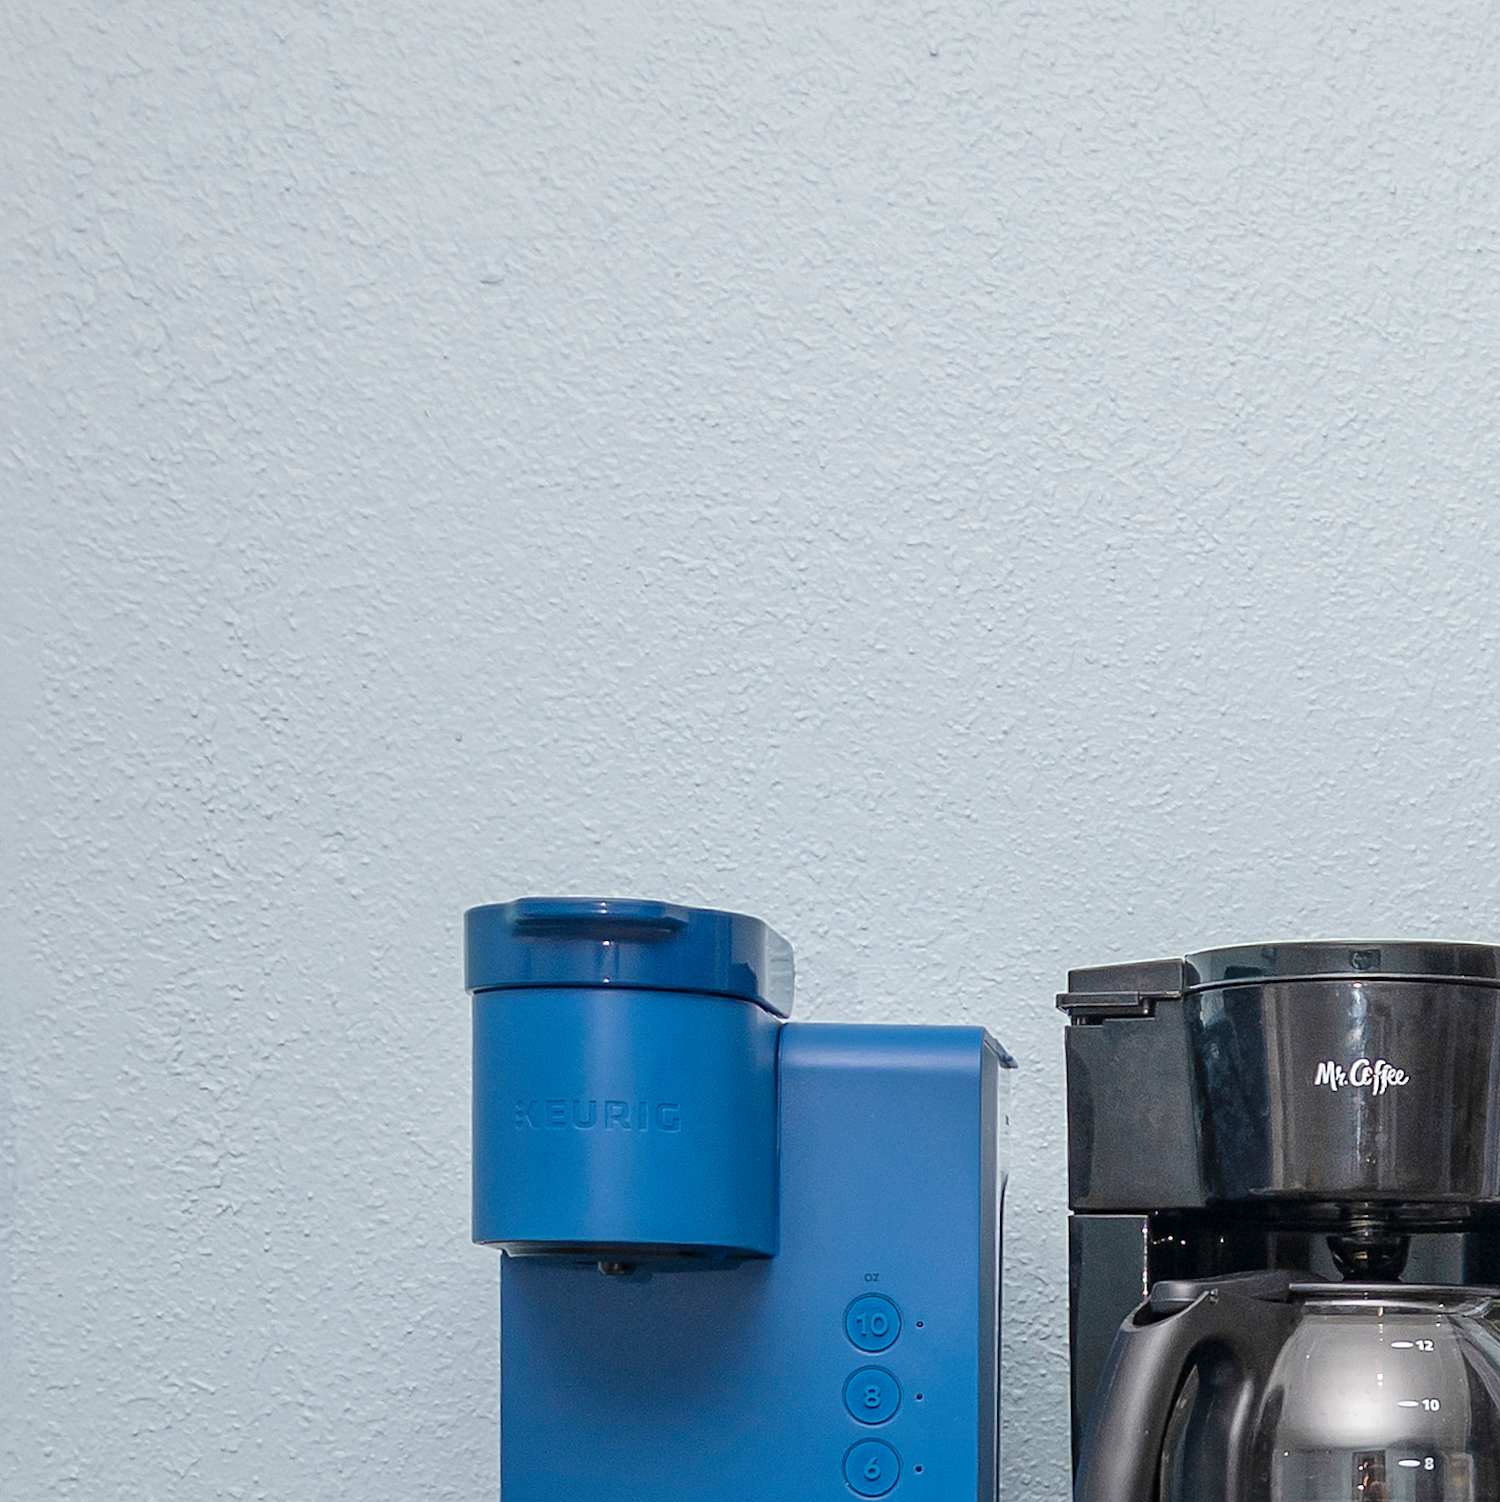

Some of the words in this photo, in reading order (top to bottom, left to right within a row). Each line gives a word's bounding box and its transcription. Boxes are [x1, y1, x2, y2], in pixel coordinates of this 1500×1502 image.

[1314, 1060, 1349, 1092] Mr.
[1349, 1058, 1411, 1097] Coffee
[514, 1099, 682, 1134] KEURIG
[856, 1312, 890, 1337] 10
[1415, 1339, 1435, 1352] 12
[863, 1384, 882, 1409] 8
[1422, 1399, 1441, 1412] 10
[863, 1456, 882, 1481] 6
[1424, 1457, 1435, 1470] 8
